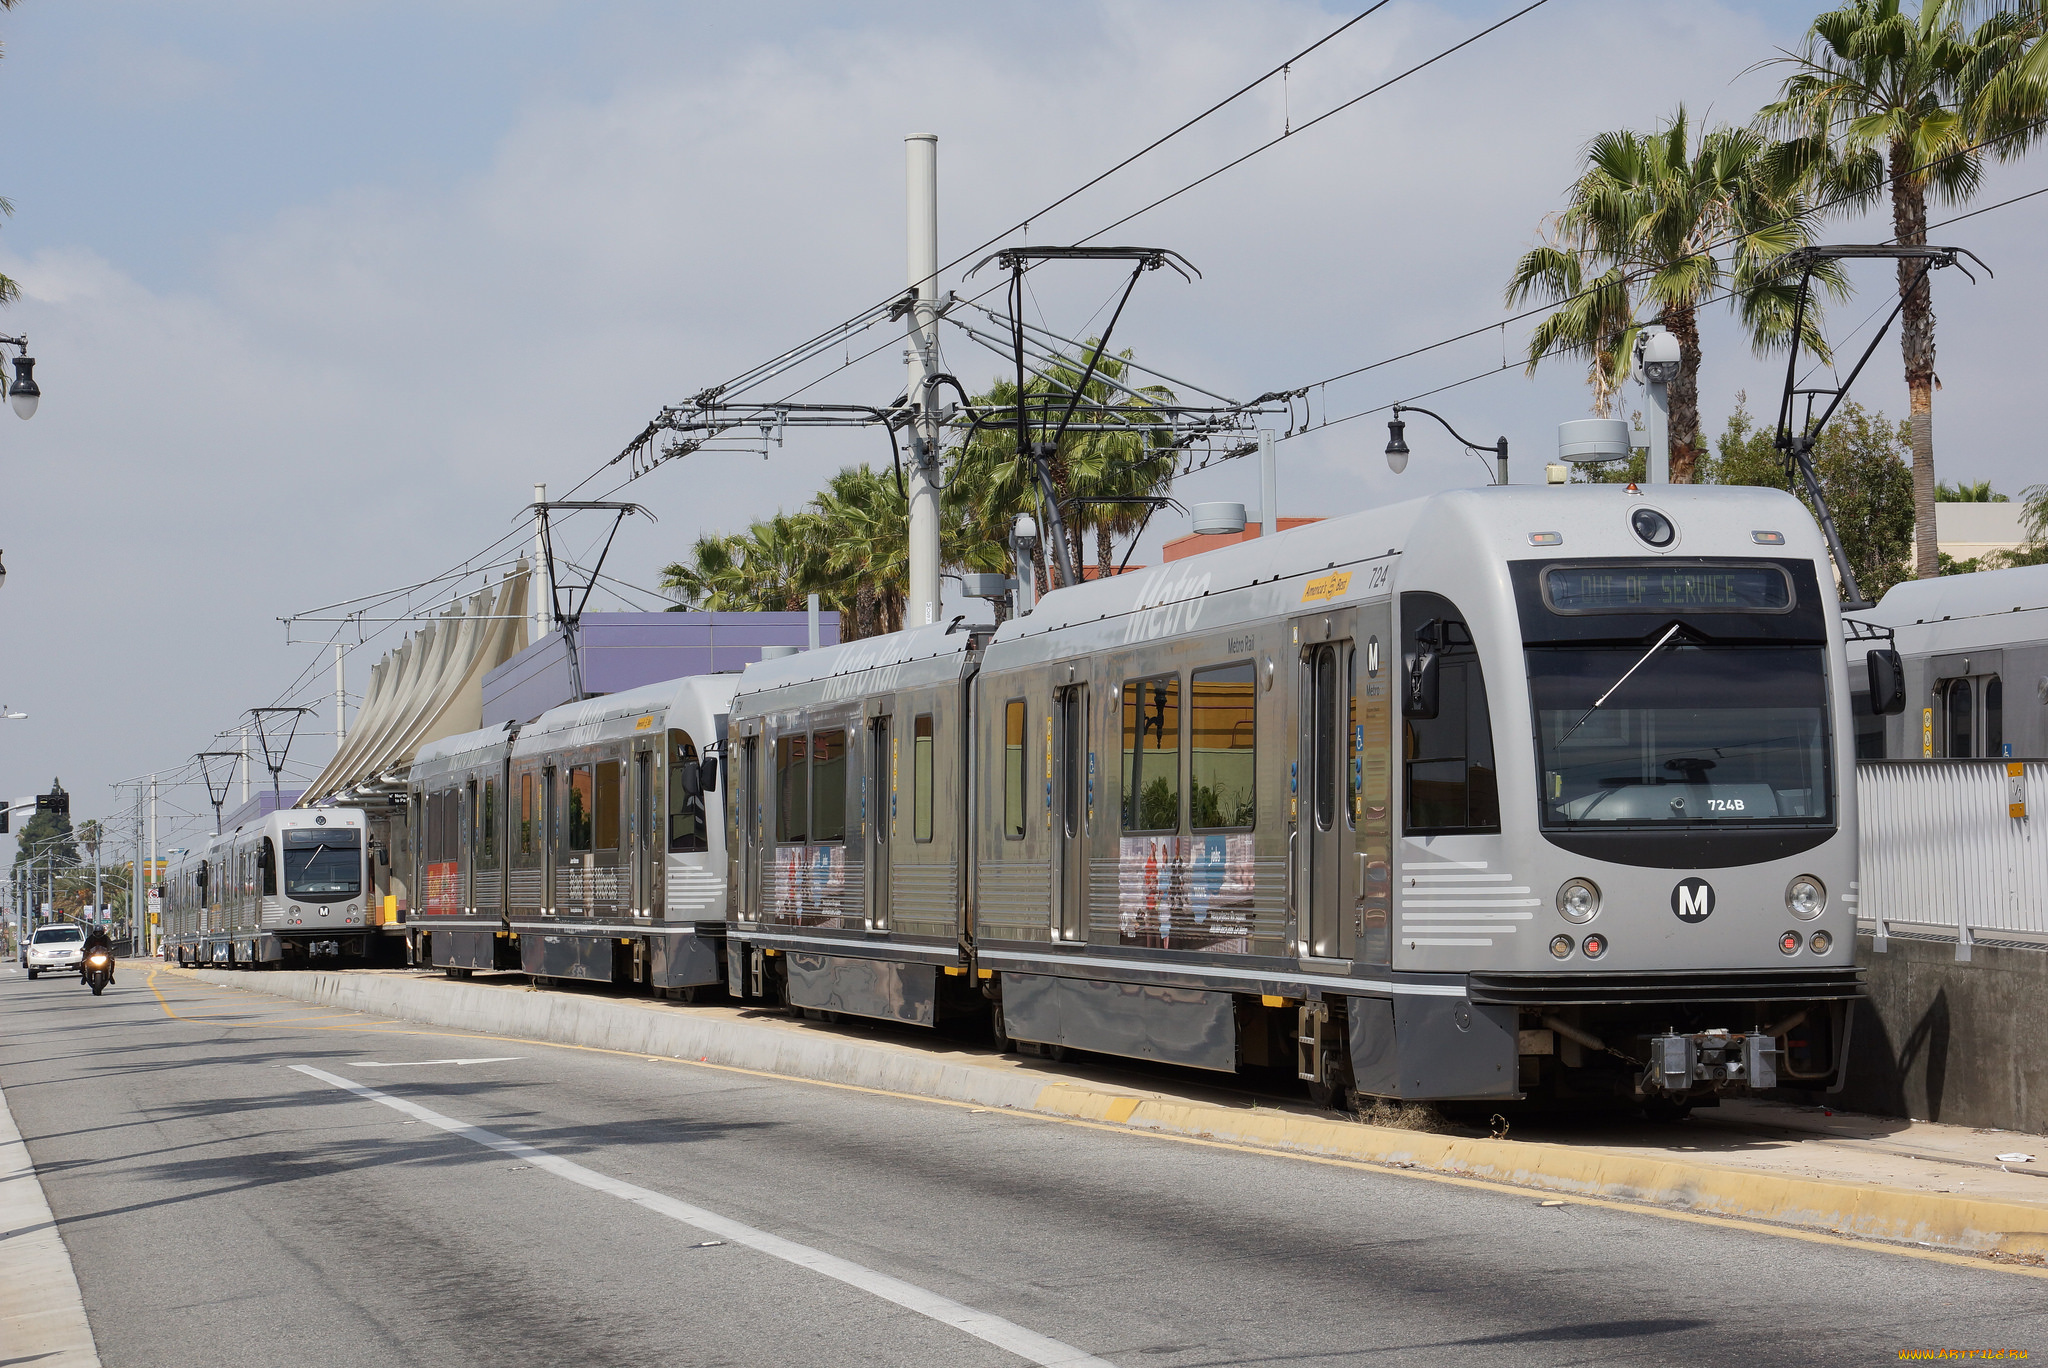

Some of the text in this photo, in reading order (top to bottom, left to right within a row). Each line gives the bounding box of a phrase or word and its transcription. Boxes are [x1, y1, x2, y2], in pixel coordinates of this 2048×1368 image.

[1368, 565, 1389, 589] 724
[1582, 574, 1737, 603] OUT OF SERVICE
[1124, 562, 1212, 644] Metro
[1227, 633, 1255, 654] Metro Rail
[822, 641, 877, 701] Metro
[1366, 684, 1380, 696] Metro
[1707, 799, 1745, 811] 724B
[1679, 885, 1708, 915] M
